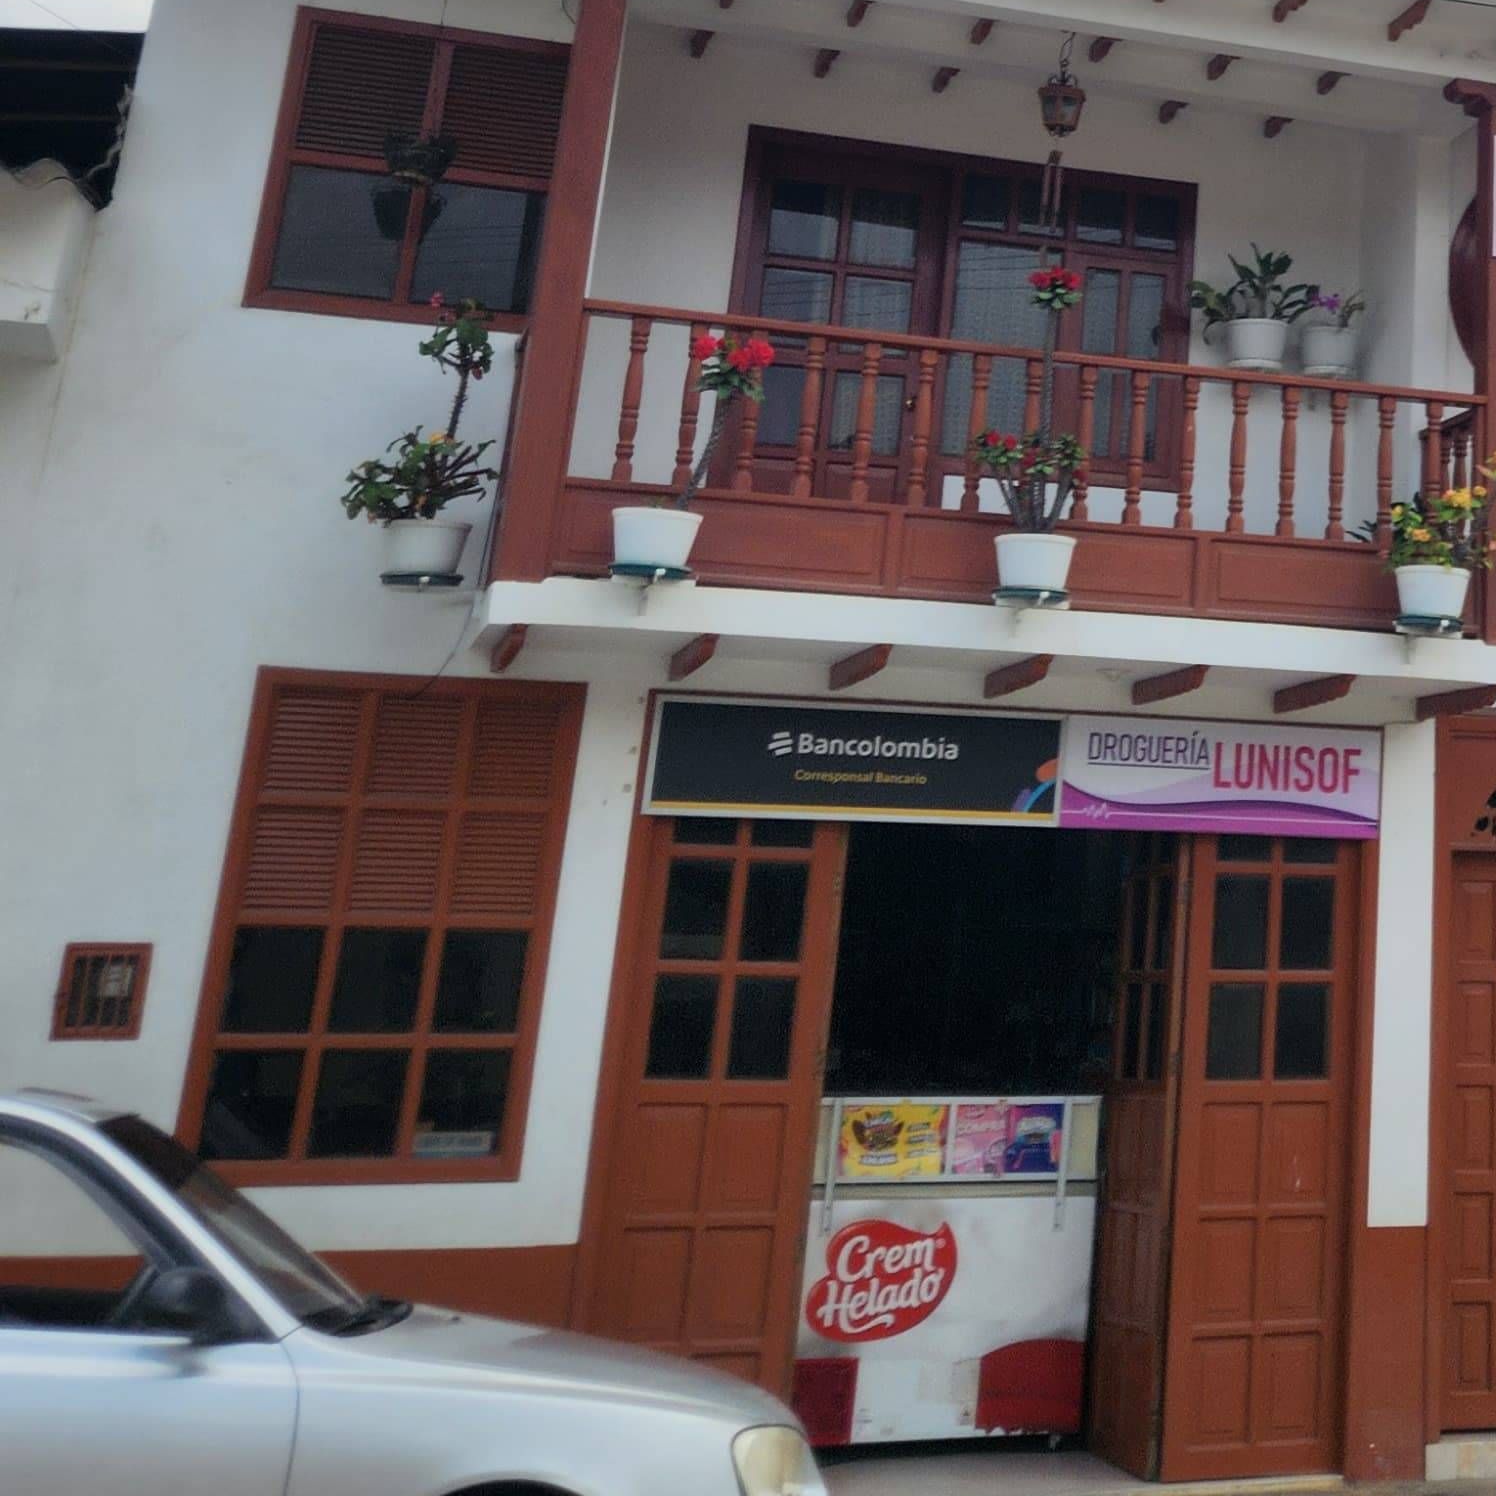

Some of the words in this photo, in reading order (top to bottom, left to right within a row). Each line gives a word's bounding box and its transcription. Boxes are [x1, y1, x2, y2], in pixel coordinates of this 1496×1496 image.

[798, 733, 960, 760] Bancolombia
[1088, 731, 1210, 766] DROGUERÍA
[1213, 741, 1362, 794] LUNISOF
[794, 769, 874, 783] Corresponsal
[875, 772, 928, 785] Bancario
[836, 1235, 935, 1284] Crem
[816, 1267, 946, 1334] Helado
